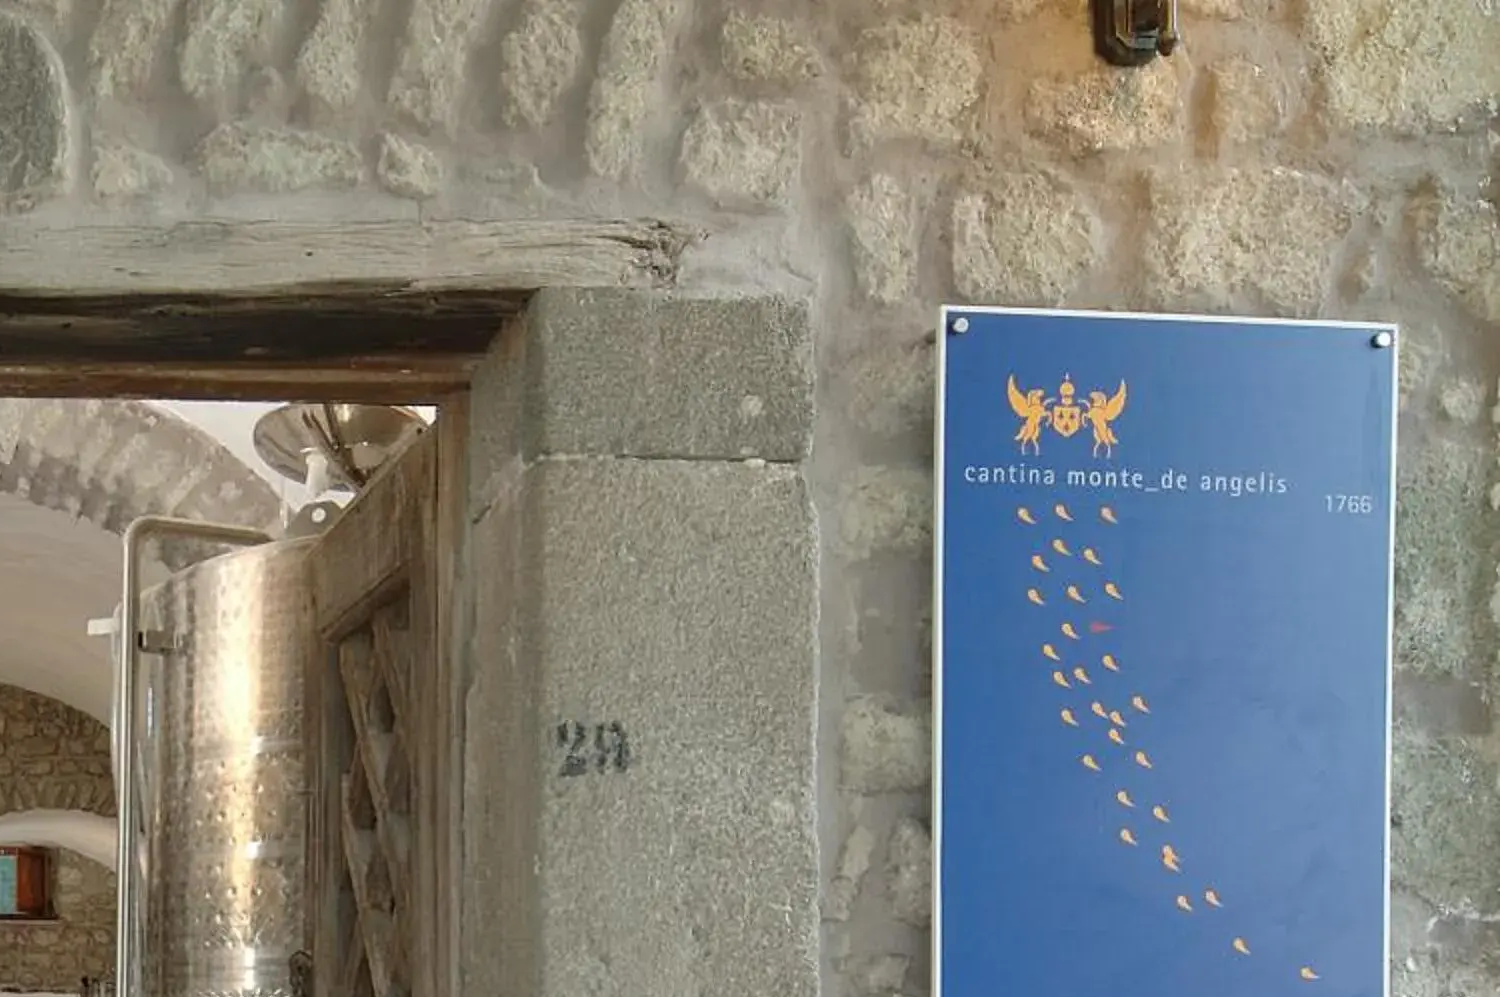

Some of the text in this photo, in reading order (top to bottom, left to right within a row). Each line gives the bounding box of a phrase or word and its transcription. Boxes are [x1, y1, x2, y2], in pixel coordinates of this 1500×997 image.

[963, 463, 1056, 485] cantina
[1200, 471, 1288, 497] angelis
[1324, 494, 1373, 514] 1766
